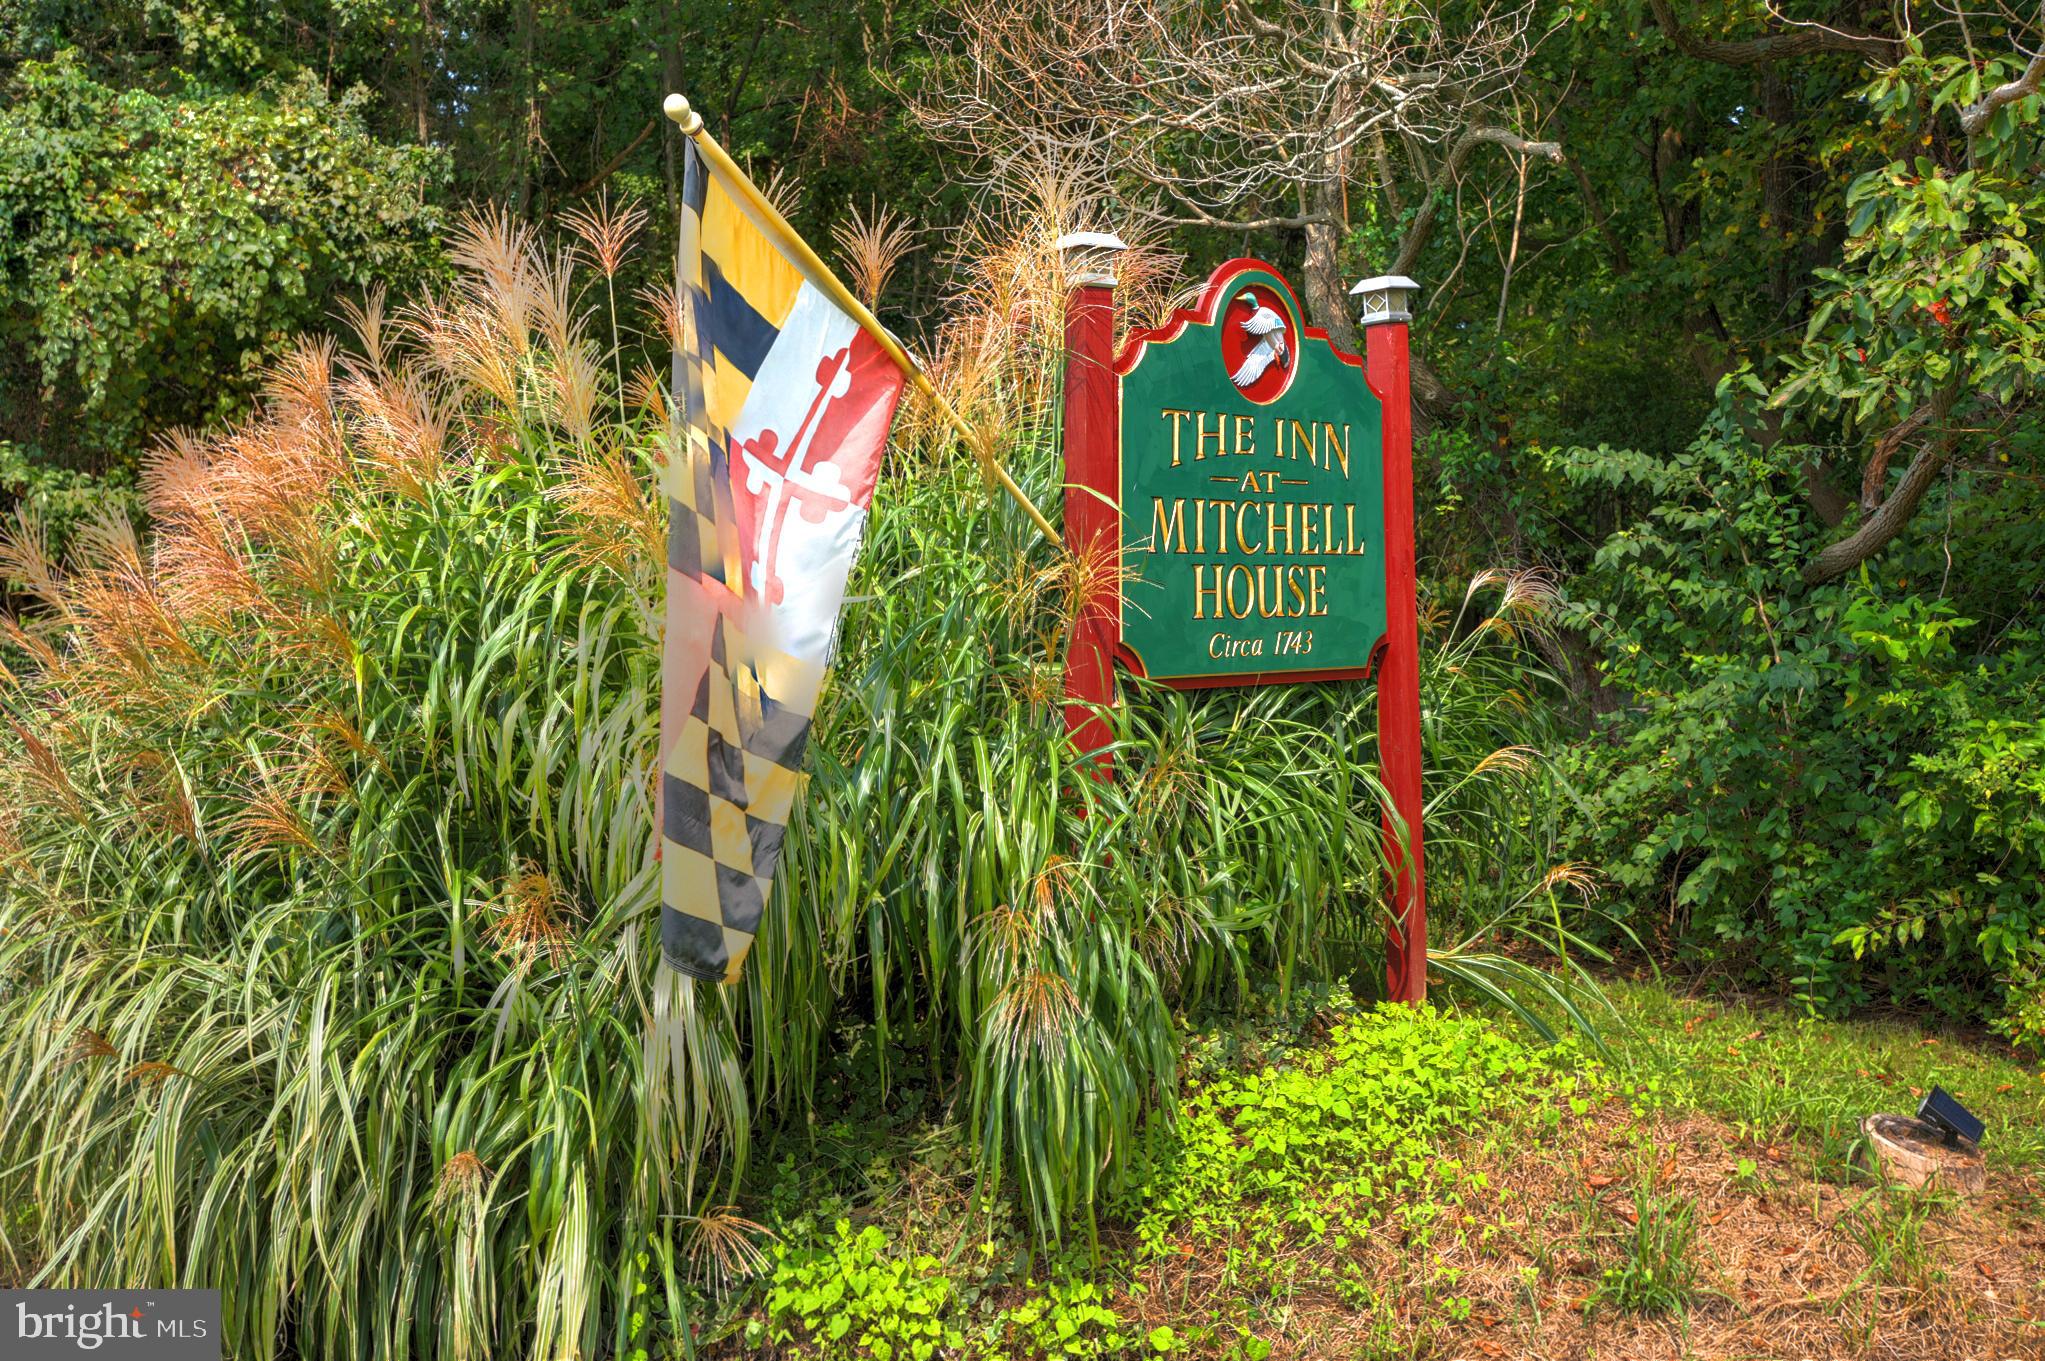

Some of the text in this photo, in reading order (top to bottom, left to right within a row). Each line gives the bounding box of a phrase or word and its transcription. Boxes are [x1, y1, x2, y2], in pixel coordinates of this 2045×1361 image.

[1161, 408, 1350, 480] THE INN
[1147, 496, 1365, 556] MITCHELL
[1192, 563, 1328, 620] HOUSE
[1208, 630, 1313, 659] Circa 1743
